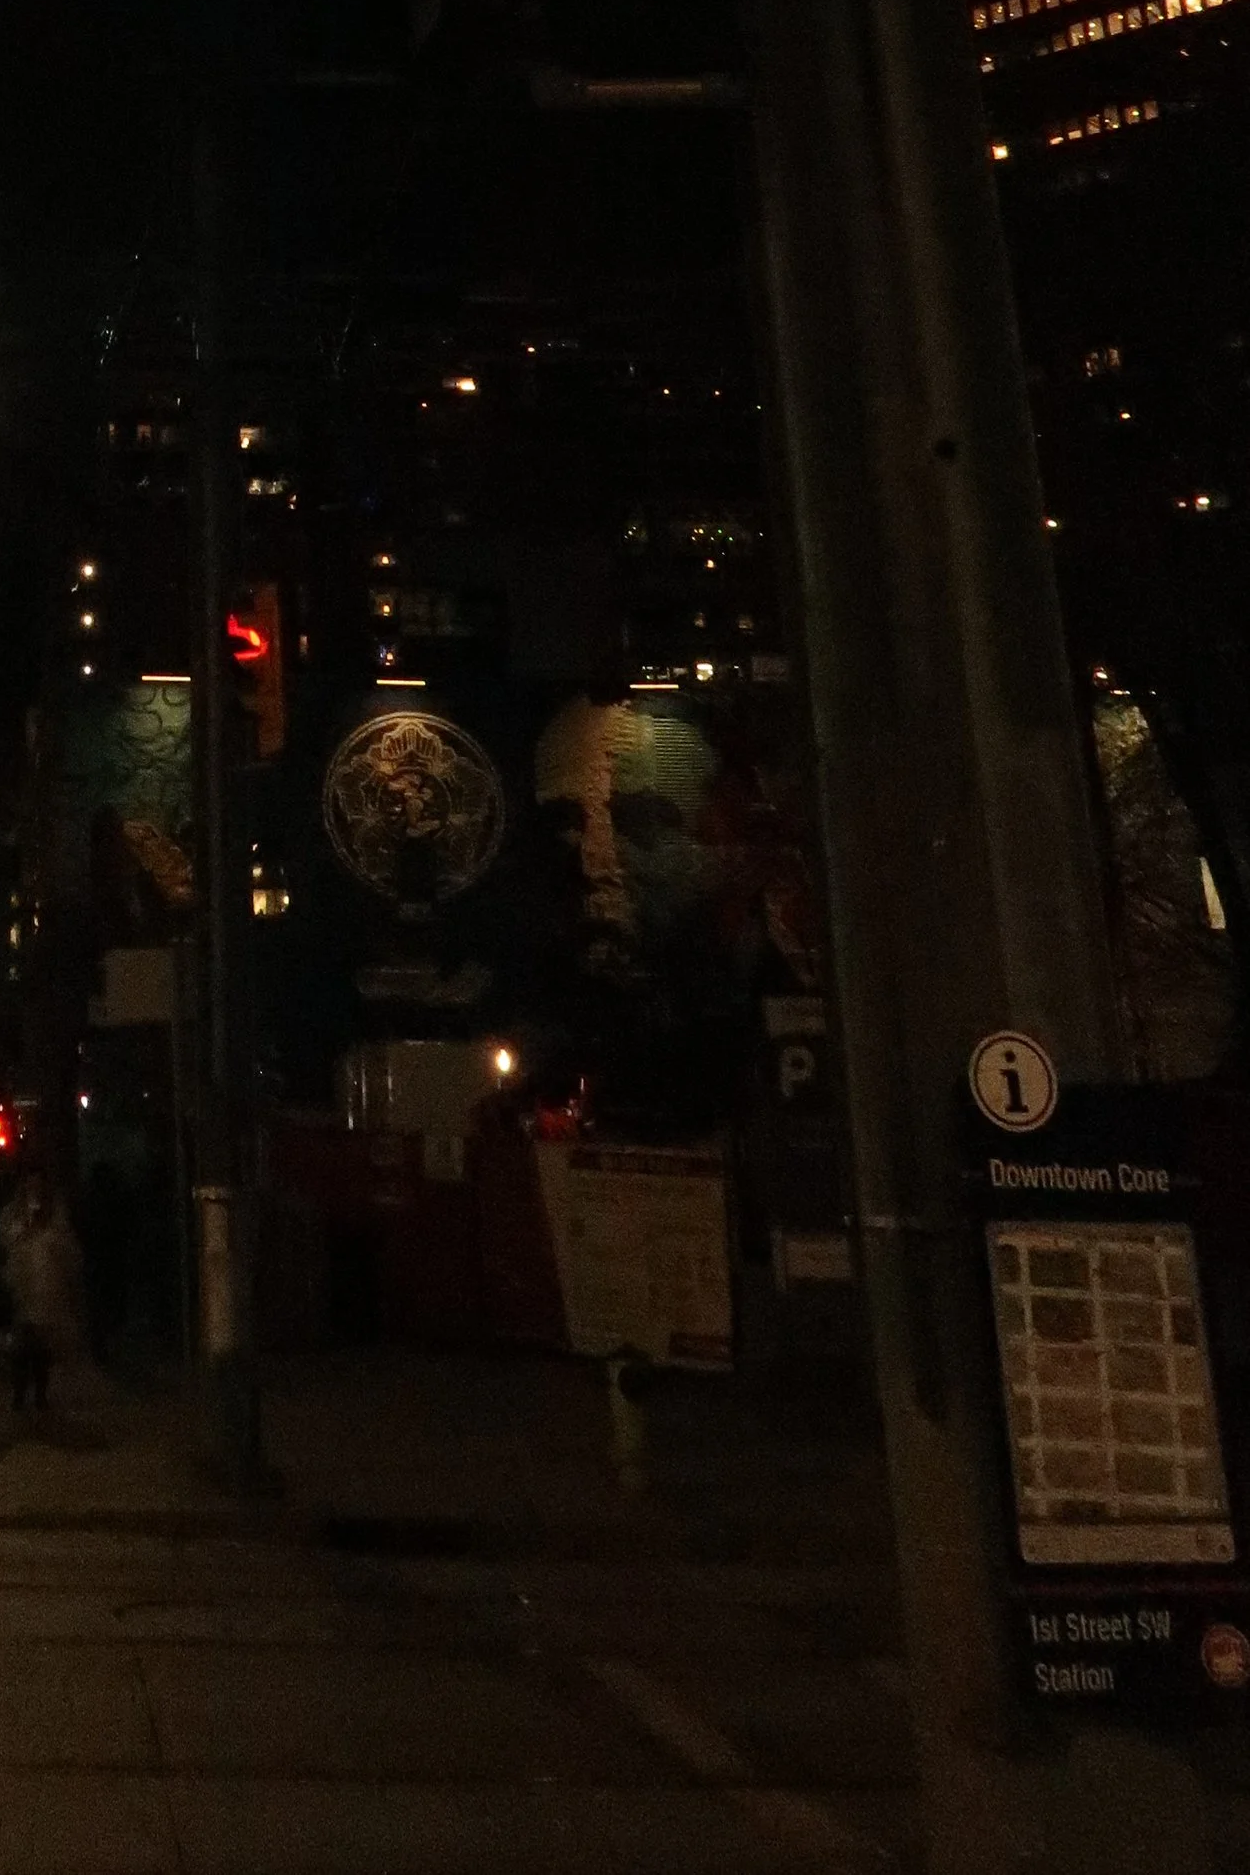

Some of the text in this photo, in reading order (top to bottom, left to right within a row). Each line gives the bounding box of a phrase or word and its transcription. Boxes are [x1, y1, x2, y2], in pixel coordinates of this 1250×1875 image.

[988, 1158, 1171, 1194] Downtown Core
[1030, 1609, 1172, 1644] 1st Street SW
[1034, 1661, 1115, 1694] Station
